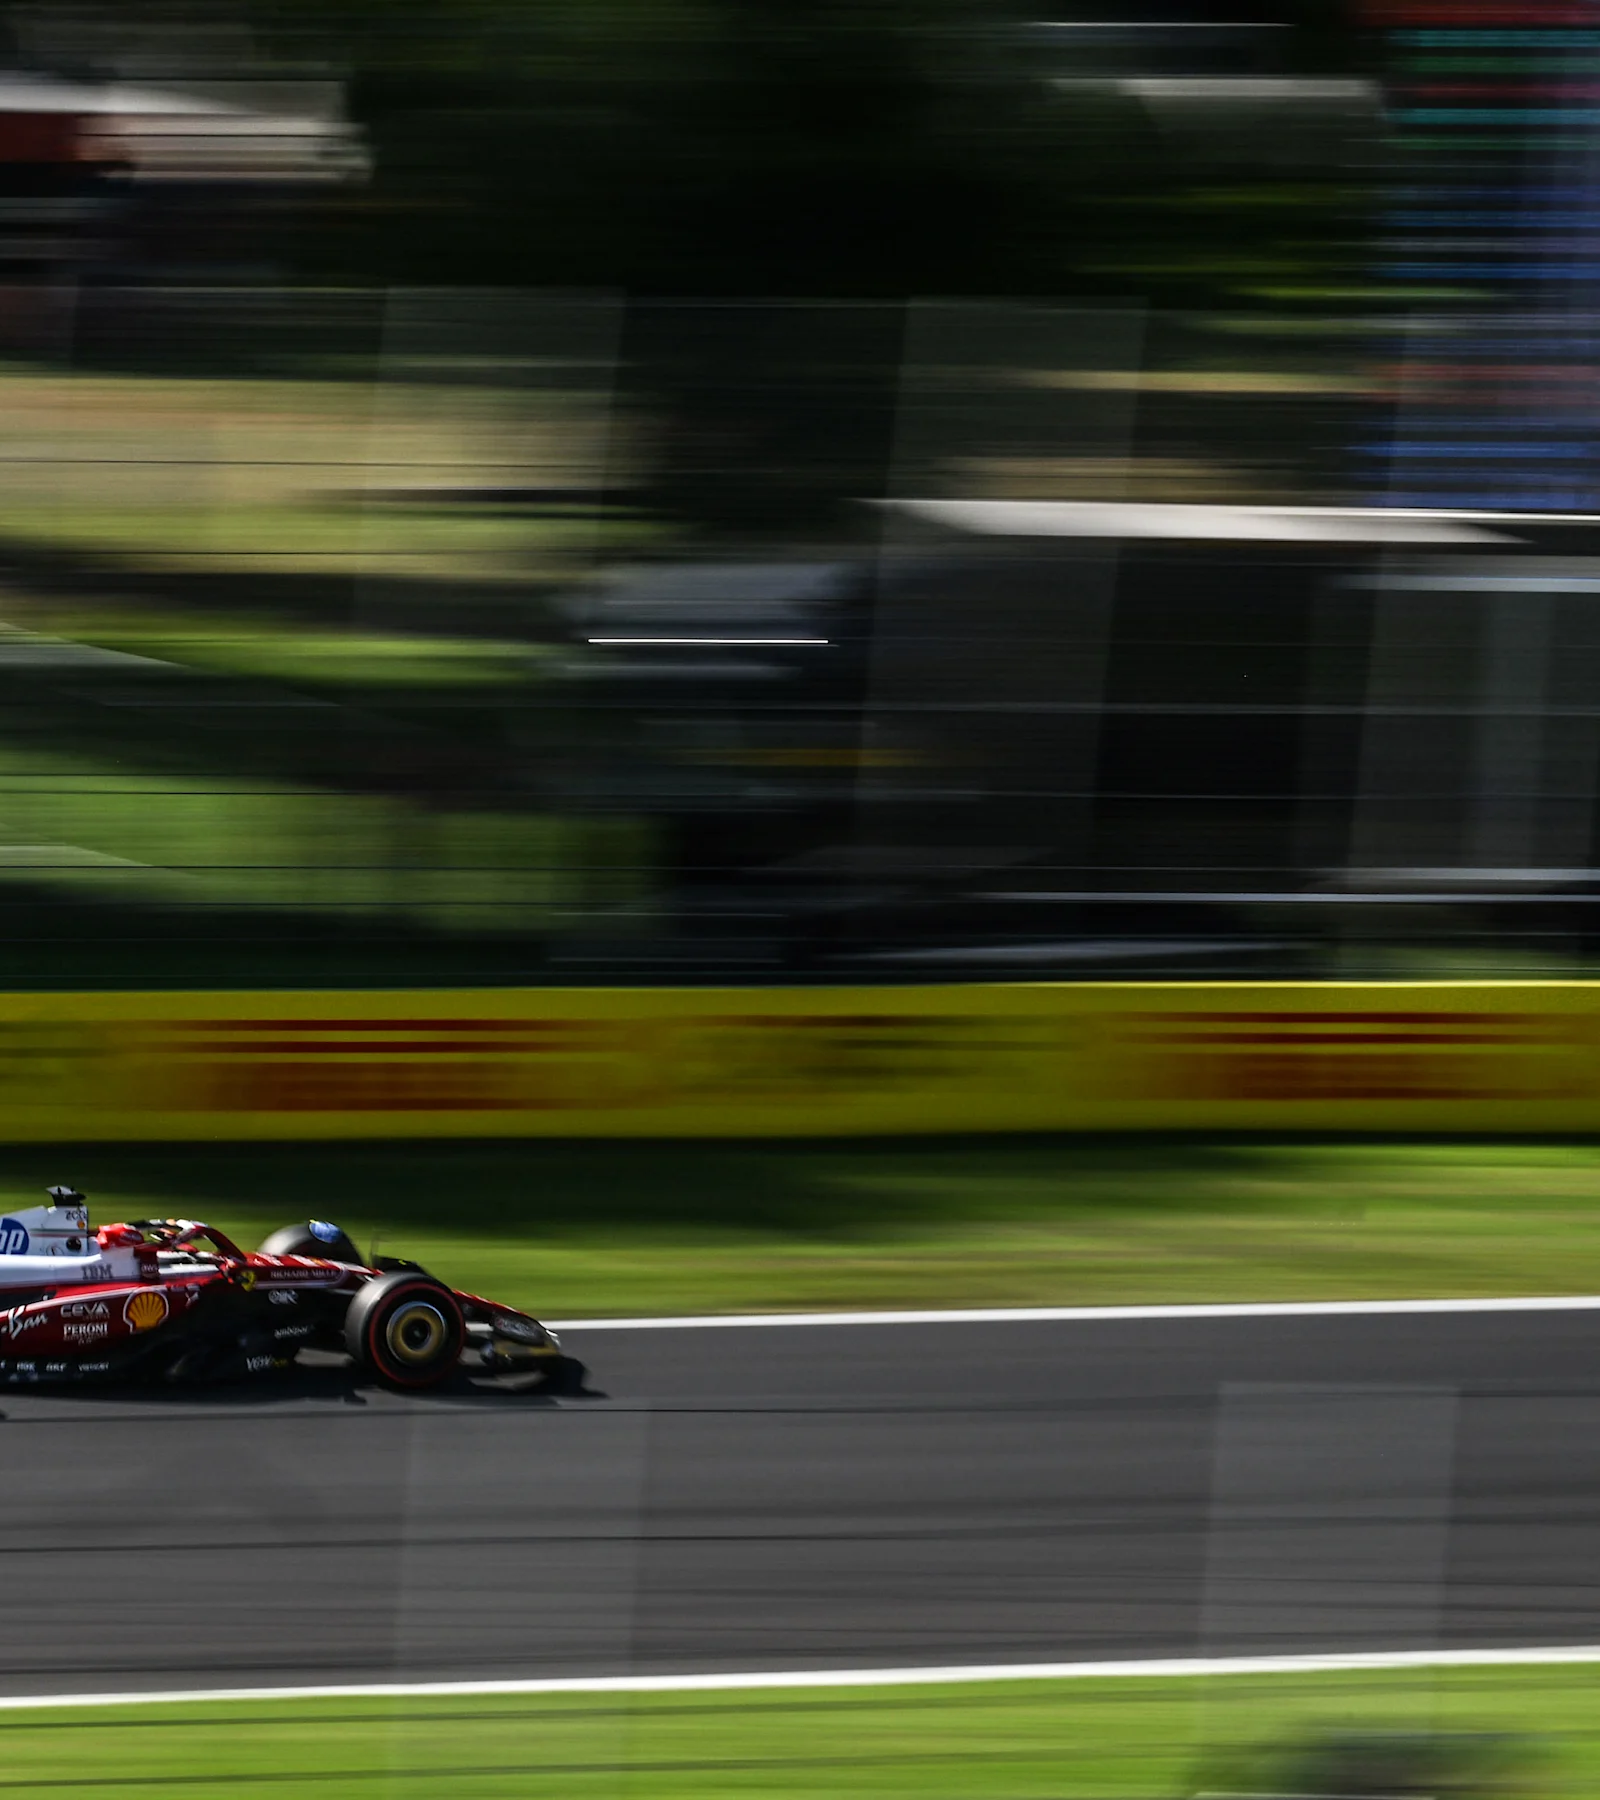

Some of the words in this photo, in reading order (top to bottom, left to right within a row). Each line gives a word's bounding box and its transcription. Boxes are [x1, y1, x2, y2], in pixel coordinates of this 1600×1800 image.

[82, 1264, 113, 1280] IBM
[60, 1301, 109, 1317] CEVA
[63, 1322, 109, 1337] PERONI
